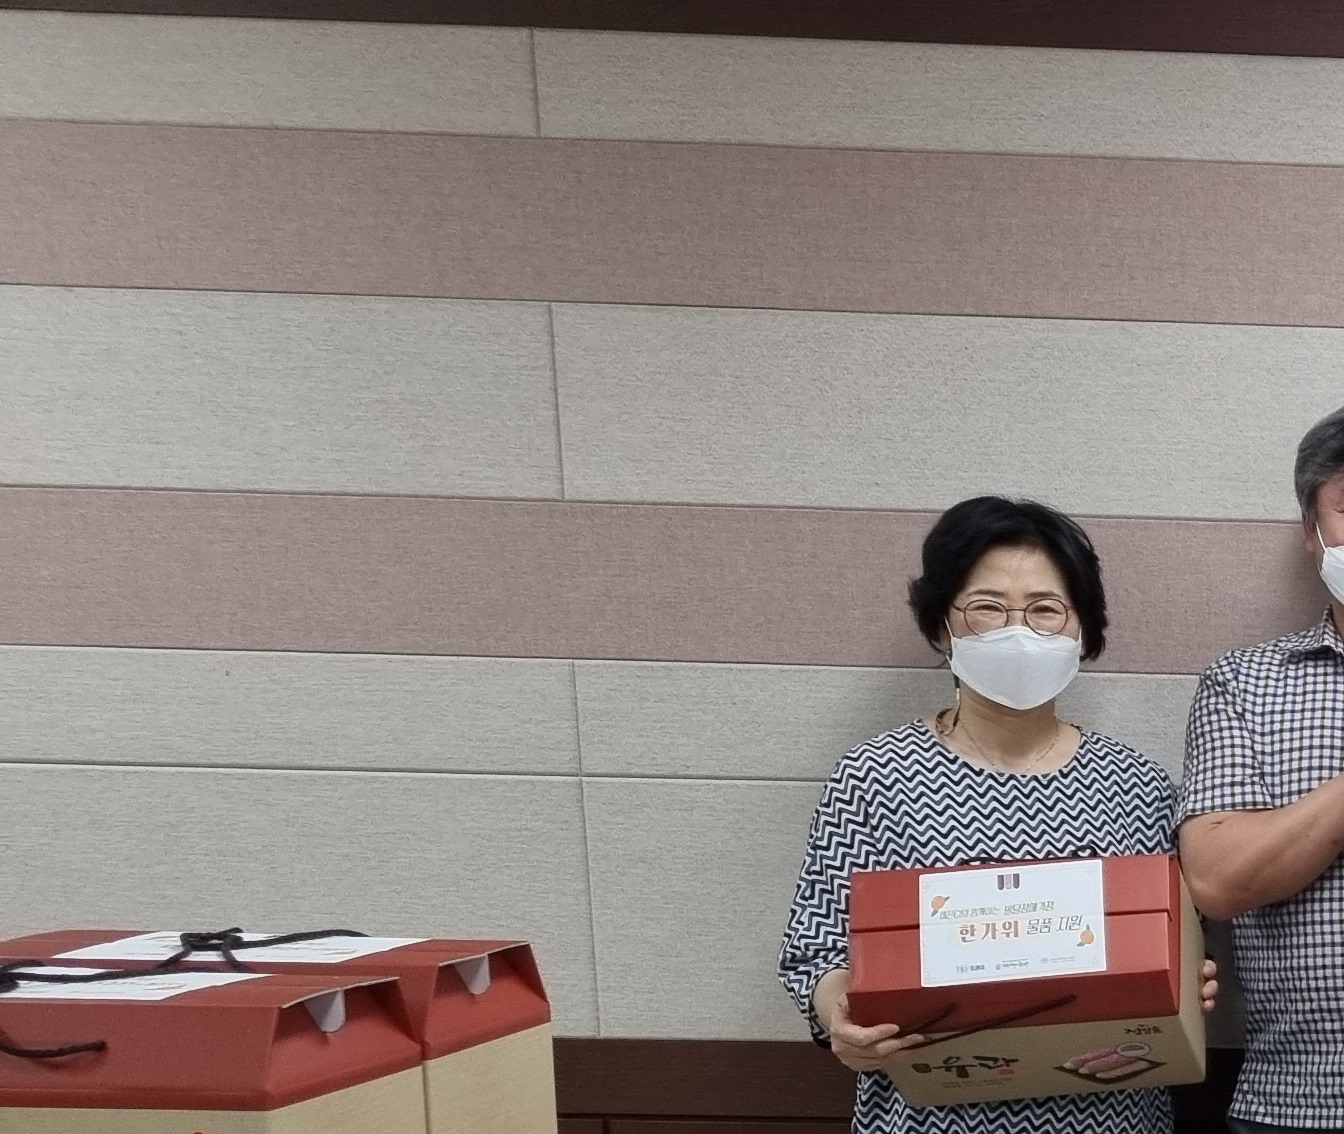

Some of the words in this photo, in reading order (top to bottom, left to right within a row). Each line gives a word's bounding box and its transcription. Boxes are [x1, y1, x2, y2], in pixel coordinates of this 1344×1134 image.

[958, 921, 1020, 944] 한가위
[1026, 919, 1052, 936] 물품
[1055, 914, 1082, 932] 지원
